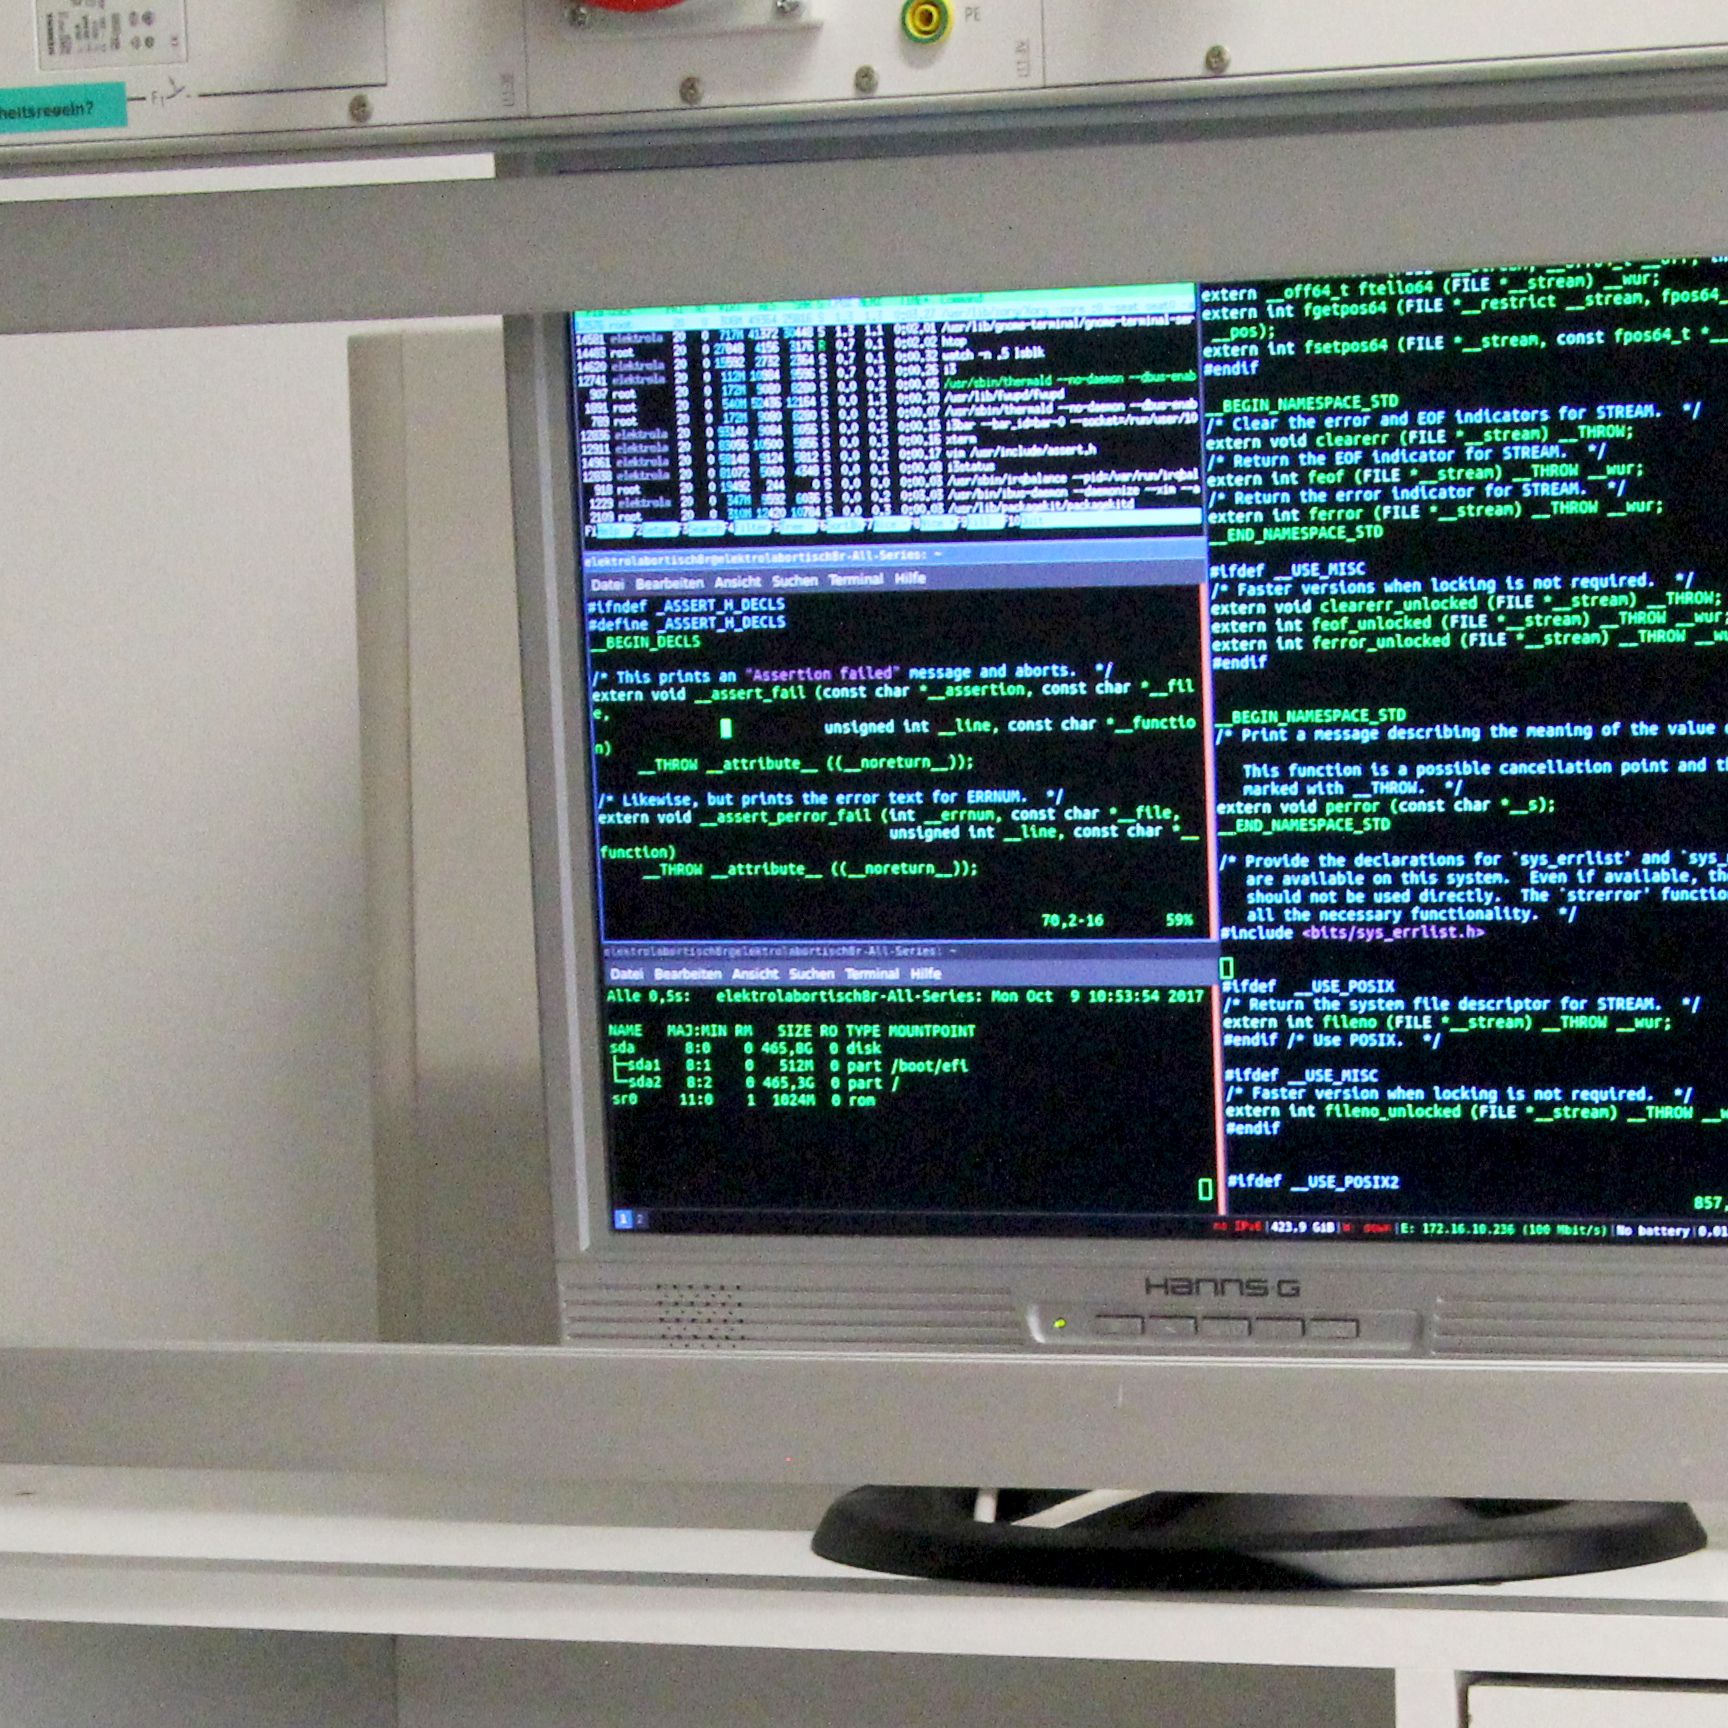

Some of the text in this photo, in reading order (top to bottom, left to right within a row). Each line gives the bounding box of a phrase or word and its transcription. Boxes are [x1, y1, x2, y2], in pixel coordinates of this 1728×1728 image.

[591, 571, 926, 591] Datei Bearbeiten Ansicht Suchen Terminal Hilfe
[587, 597, 785, 615] #ifndef _ASSERT_H_DECLS
[587, 616, 786, 634] #define _ASSERT_H_DECLS
[589, 635, 701, 653] __BEGIN_DECLS
[616, 663, 1075, 688] This prints an "Assertion failed" message and aborts.
[1214, 708, 1406, 727] __BEGIN_NAMESPACE_STD
[1242, 725, 1288, 741] Print
[1296, 729, 1306, 741] a
[1314, 723, 1380, 743] message
[1389, 724, 1482, 741] describing
[1490, 723, 1520, 738] the
[1527, 723, 1595, 740] meaning
[1601, 721, 1622, 736] of
[1630, 721, 1660, 736] the
[1668, 720, 1718, 735] value
[1243, 763, 1280, 778] This
[1289, 763, 1362, 781] function
[1371, 762, 1390, 776] is
[1398, 765, 1408, 776] a
[1417, 760, 1492, 779] possible
[1501, 759, 1614, 775] cancellation
[1622, 758, 1670, 775] point
[1678, 757, 1709, 772] and
[1245, 853, 1310, 868] Provide
[1319, 853, 1346, 868] the
[1355, 852, 1465, 867] declarations
[1476, 851, 1502, 866] for
[1643, 850, 1670, 865] and
[1042, 914, 1104, 929] 70,2-16
[1166, 913, 1194, 926] 59%
[1220, 922, 1485, 942] #include <bits/sys_errlist.h>
[610, 967, 942, 980] Datei Bearbeiten Ansicht Suchen Terminal Hilfe
[608, 989, 640, 1002] Alle
[649, 989, 691, 1003] 0,5s:
[993, 989, 1019, 1002] Mon
[1027, 989, 1054, 1002] Oct
[1071, 989, 1080, 1002] 9
[1089, 989, 1159, 1003] 10:53:54
[1167, 989, 1204, 1003] 2017
[1221, 979, 1396, 997] #ifdef __USE_POSIX
[609, 1024, 975, 1038] NAME MAJ:MIN RM SIZE RO TYPE MOUNTPOINT
[891, 1059, 968, 1077] /boot/efi
[1617, 1225, 1633, 1237] No
[1638, 1225, 1691, 1238] battery
